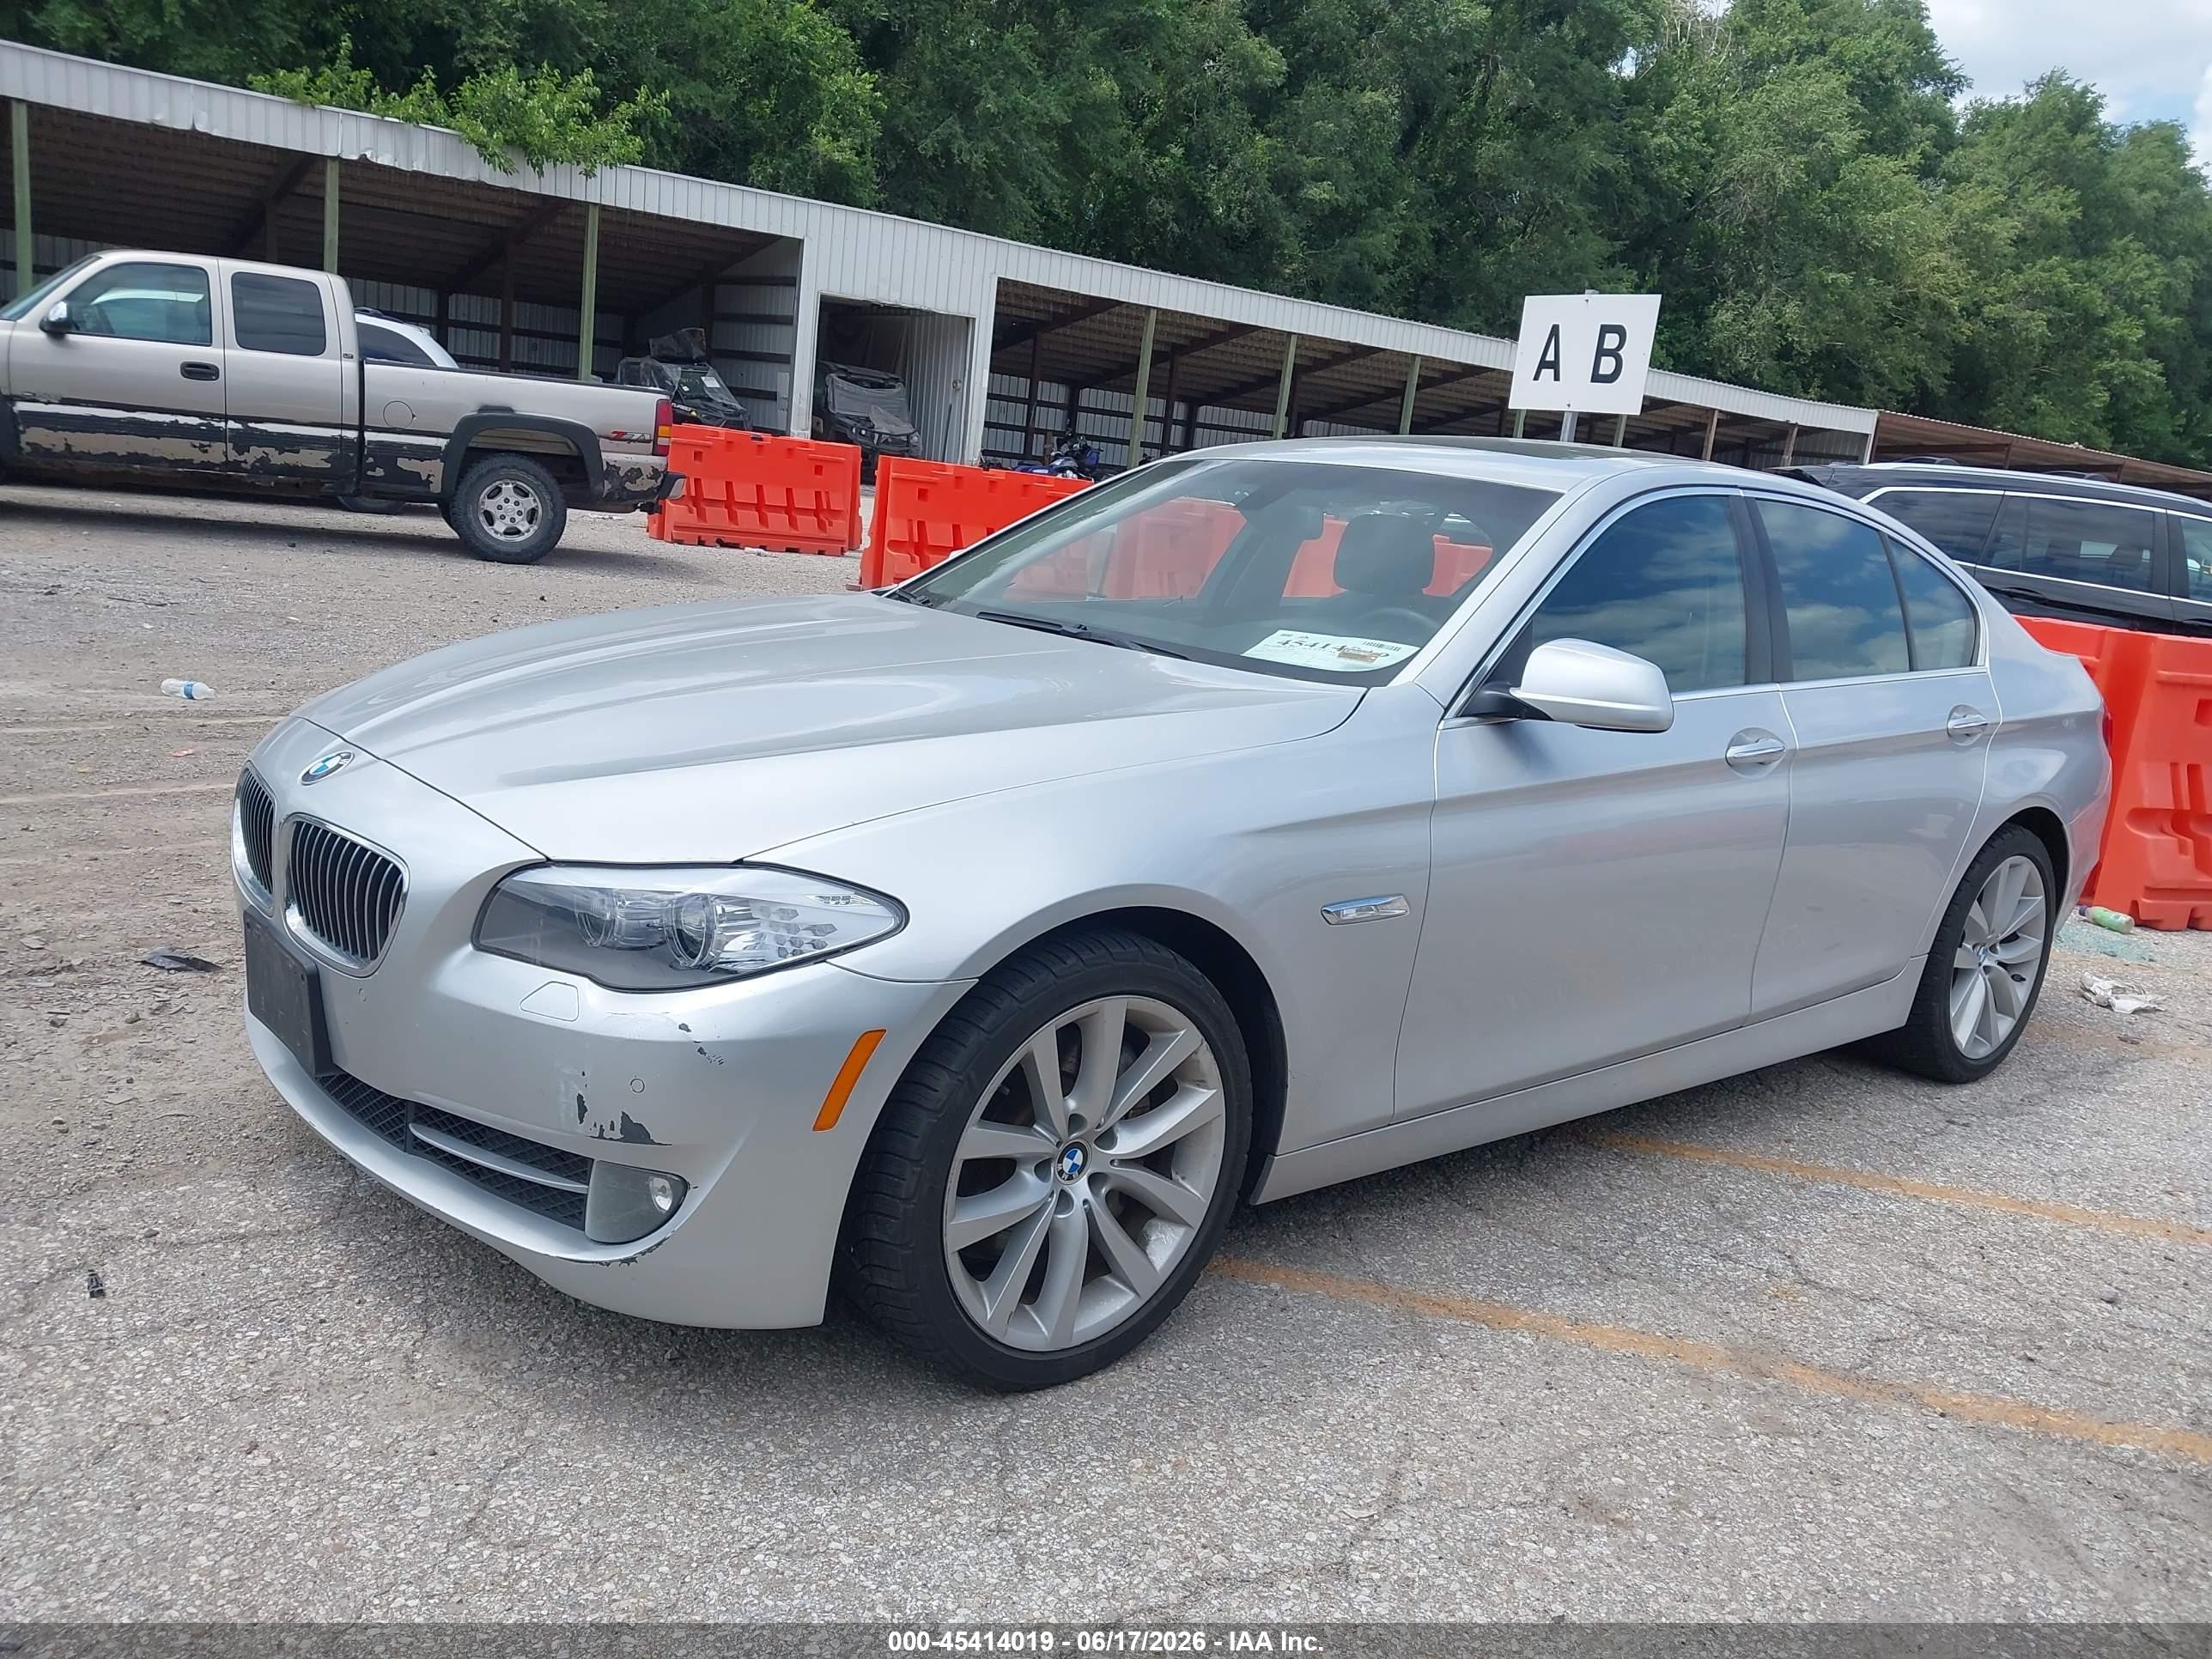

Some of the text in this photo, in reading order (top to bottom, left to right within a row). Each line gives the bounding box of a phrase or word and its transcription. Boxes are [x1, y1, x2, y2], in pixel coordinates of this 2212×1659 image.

[1532, 323, 1627, 384] A B
[610, 430, 653, 443] Z71
